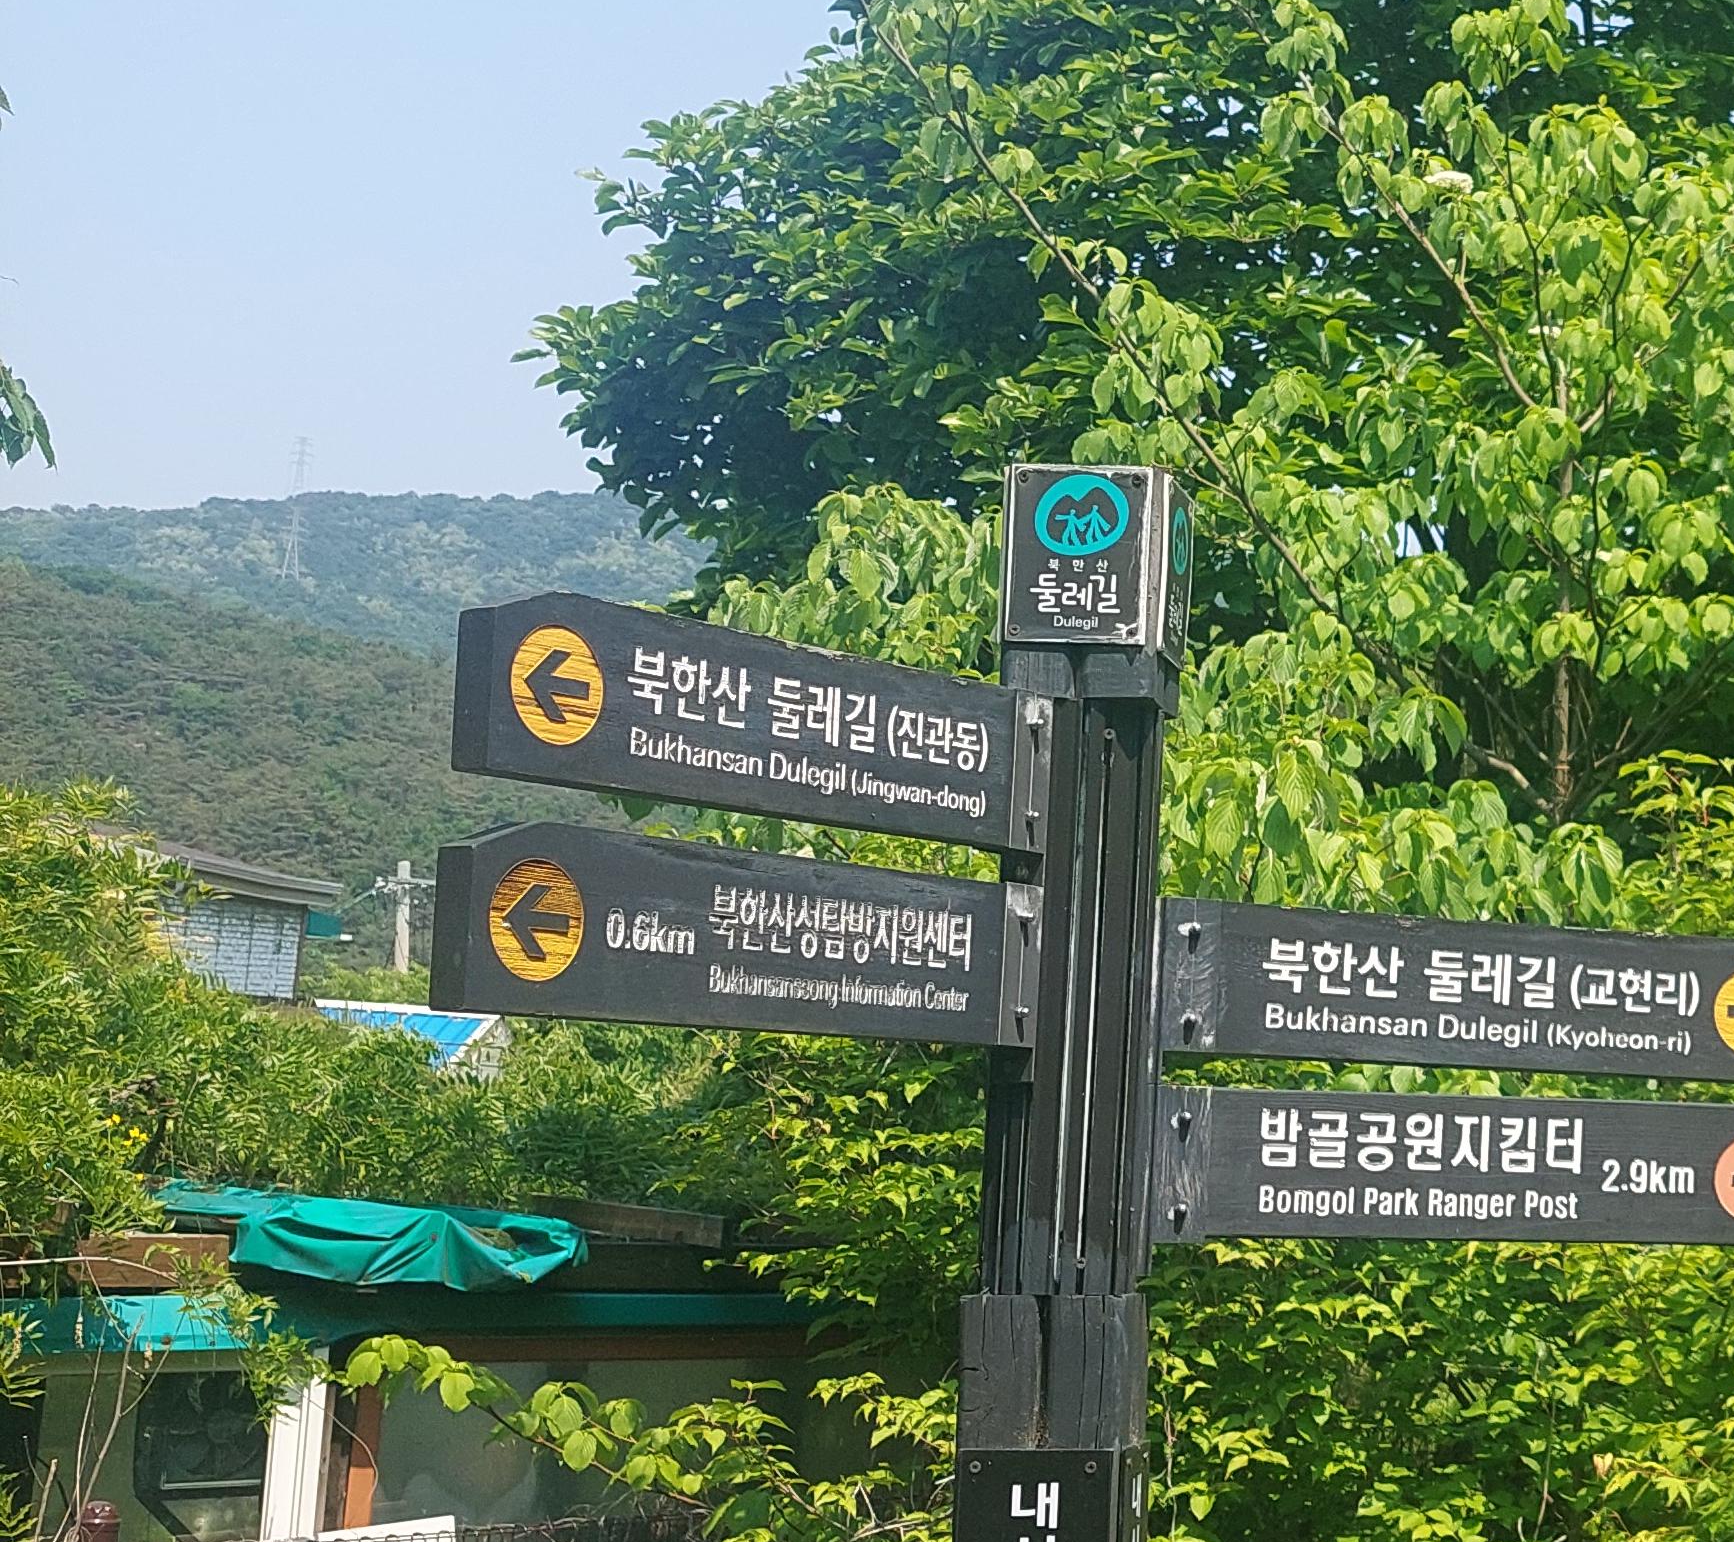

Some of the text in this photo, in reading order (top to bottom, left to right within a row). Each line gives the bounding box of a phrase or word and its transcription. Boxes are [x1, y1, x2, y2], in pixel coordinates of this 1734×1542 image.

[1047, 558, 1109, 573] 북한산
[1030, 573, 1121, 614] 둘레길
[1053, 615, 1099, 630] Dulegil
[627, 645, 989, 773] 북한산 둘레길 (진관동)
[629, 726, 985, 818] Bukhansan Dulegil (Jingwan-dong)
[606, 907, 695, 955] 0.6km
[708, 884, 972, 971] 북한산성탐방지원센터
[708, 963, 970, 1012] Bukhansanseong Information Center
[1262, 937, 1700, 1017] 북한산 둘레길 (교현리)
[1264, 1003, 1692, 1056] Bukhansan Dulegil (Kyoheon-ri)
[1260, 1107, 1584, 1174] 밤골공원지킴터
[1601, 1158, 1695, 1195] 2.9km
[1258, 1185, 1578, 1220] Bomgol Park Ranger Post
